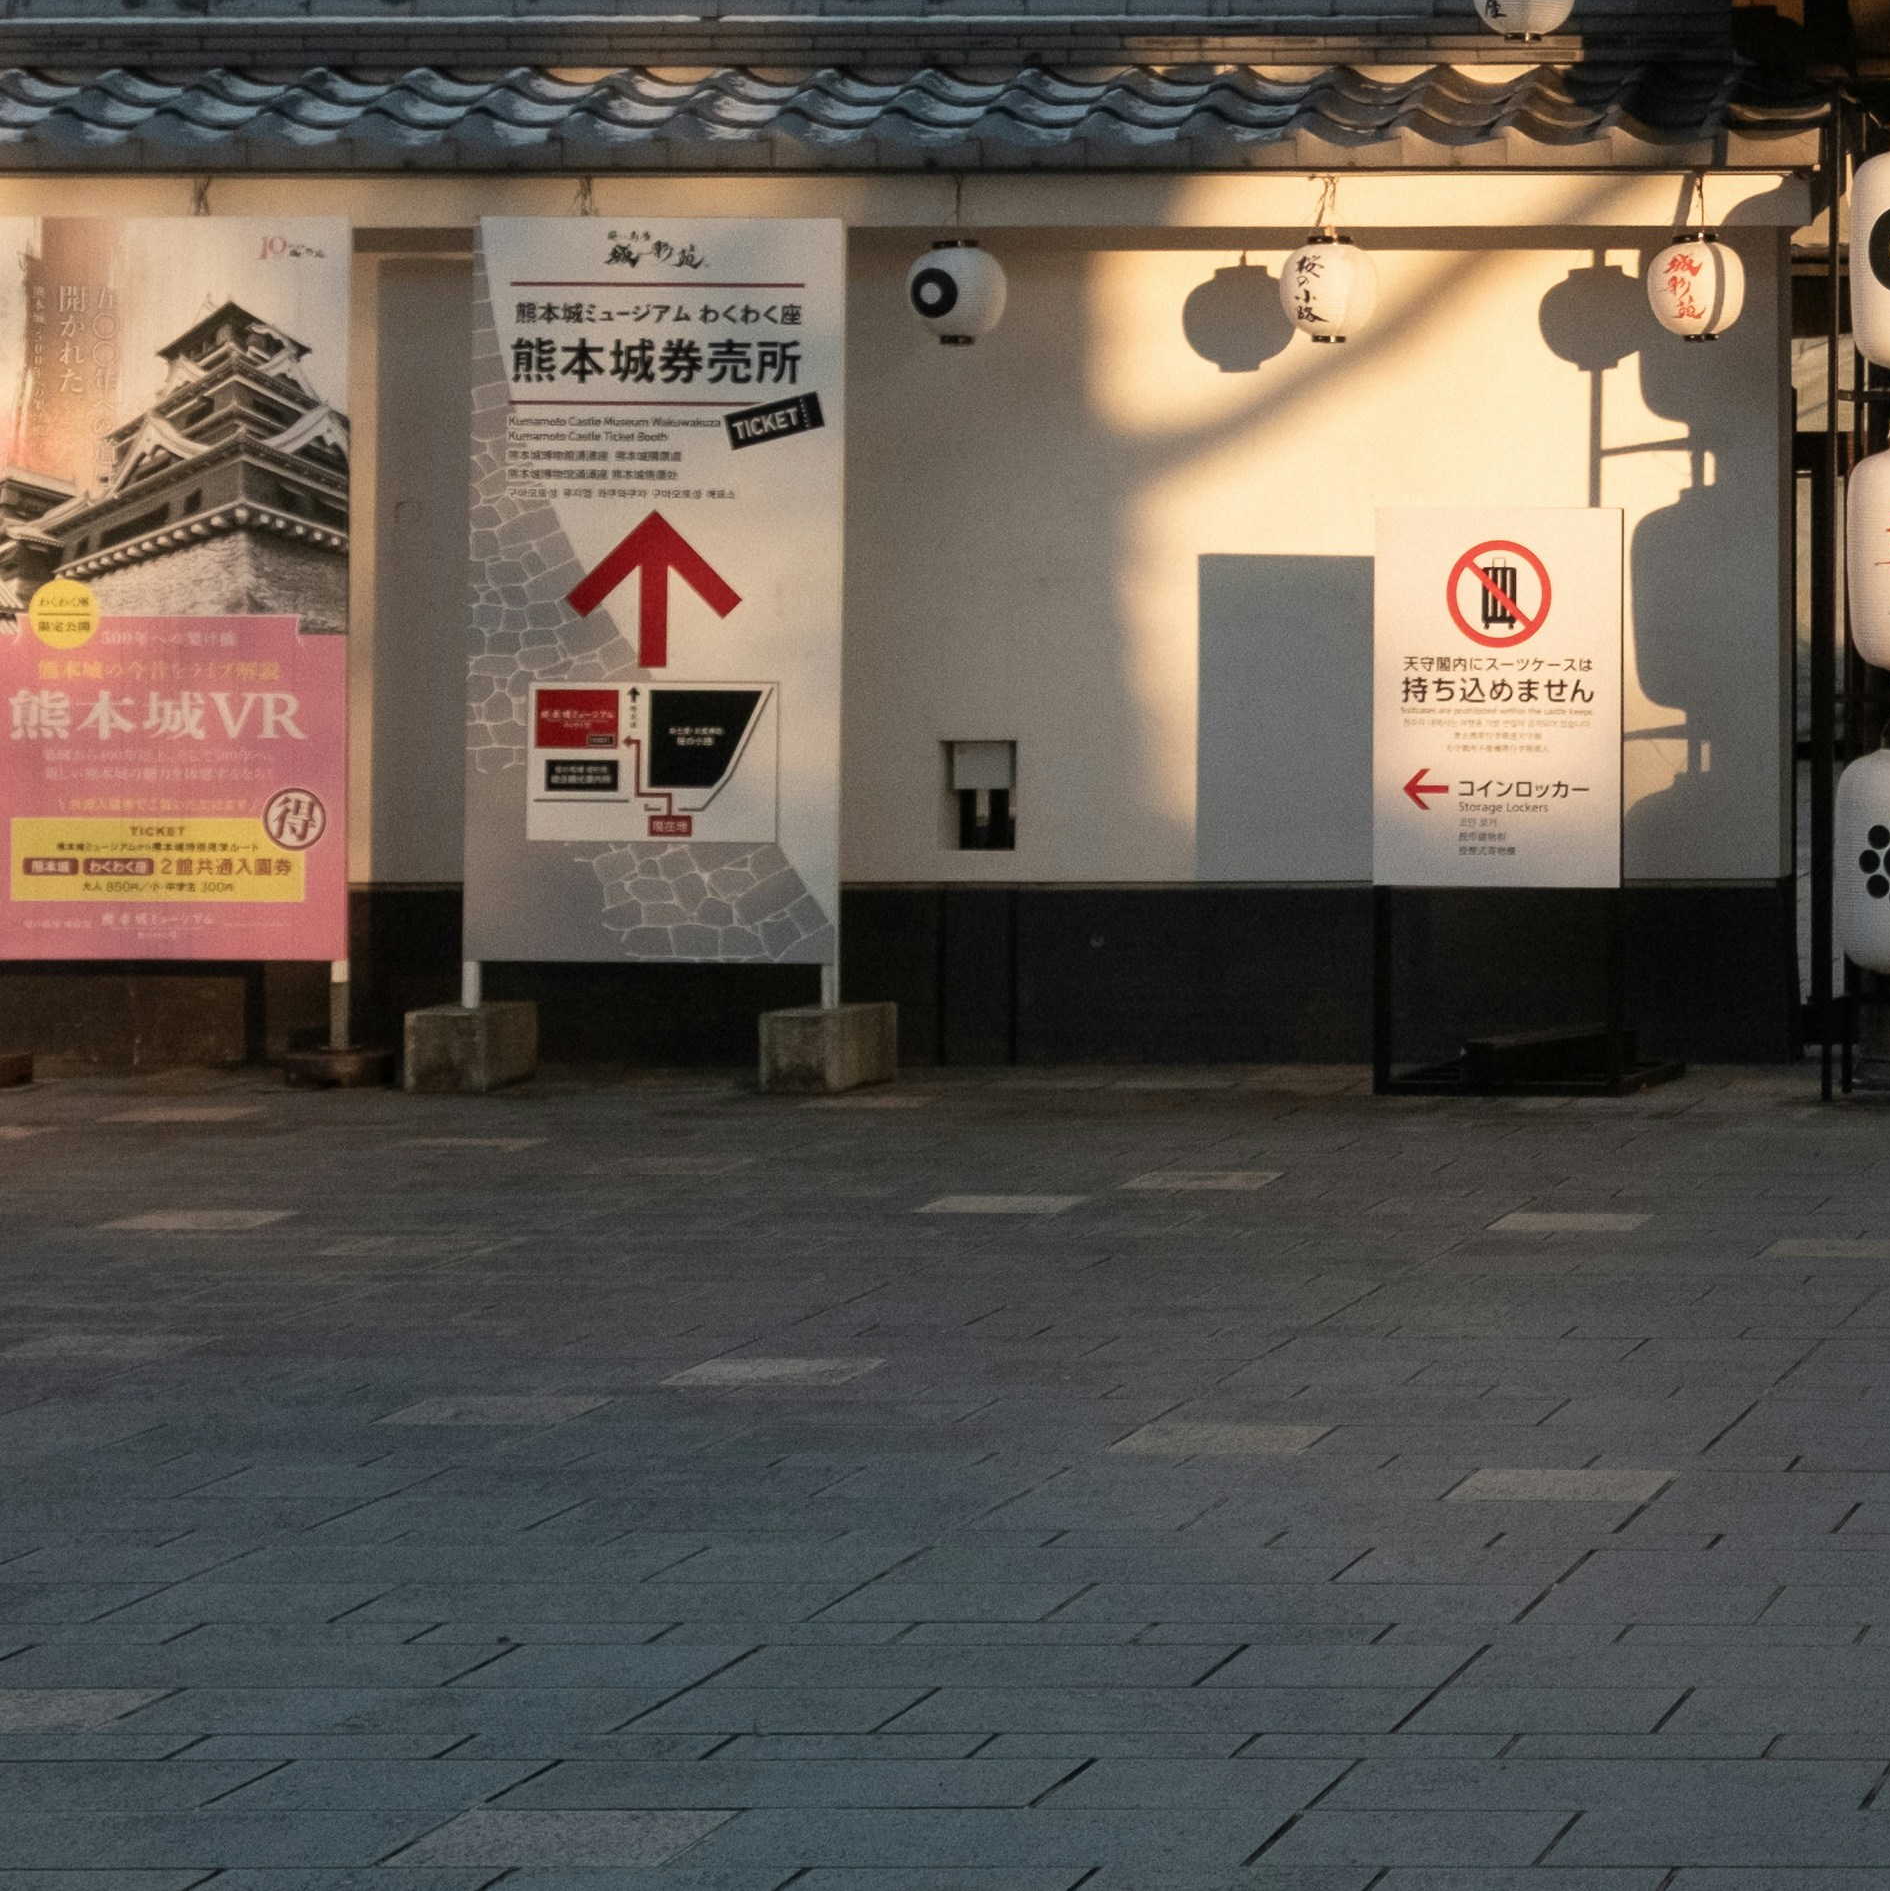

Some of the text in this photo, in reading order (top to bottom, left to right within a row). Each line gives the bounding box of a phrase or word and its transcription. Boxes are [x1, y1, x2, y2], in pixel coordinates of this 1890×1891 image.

[1295, 255, 1330, 323] 桜の小路
[1663, 252, 1707, 320] 城彩苑
[514, 302, 803, 326] 熊本城ミュージアム わくわく座
[510, 337, 802, 385] 熊本城券売所
[508, 417, 722, 428] Kumamoto Castle Museum Wakuwakuza
[732, 408, 799, 440] TICKET
[508, 431, 668, 442] Kumamoto Castle Ticket Booth
[37, 620, 91, 634] 限定公開
[1403, 656, 1593, 672] 天守閣内にスーツケースは
[1401, 677, 1594, 703] 持ち込めません
[9, 689, 308, 741] 熊本城VR
[1458, 780, 1590, 799] コインロッカー
[1458, 801, 1549, 815] Storage Lockers
[277, 796, 317, 843] 得
[652, 821, 688, 833] 現在地
[130, 826, 186, 837] TICKET
[31, 861, 70, 873] 熊本城
[88, 861, 148, 874] わくわく座
